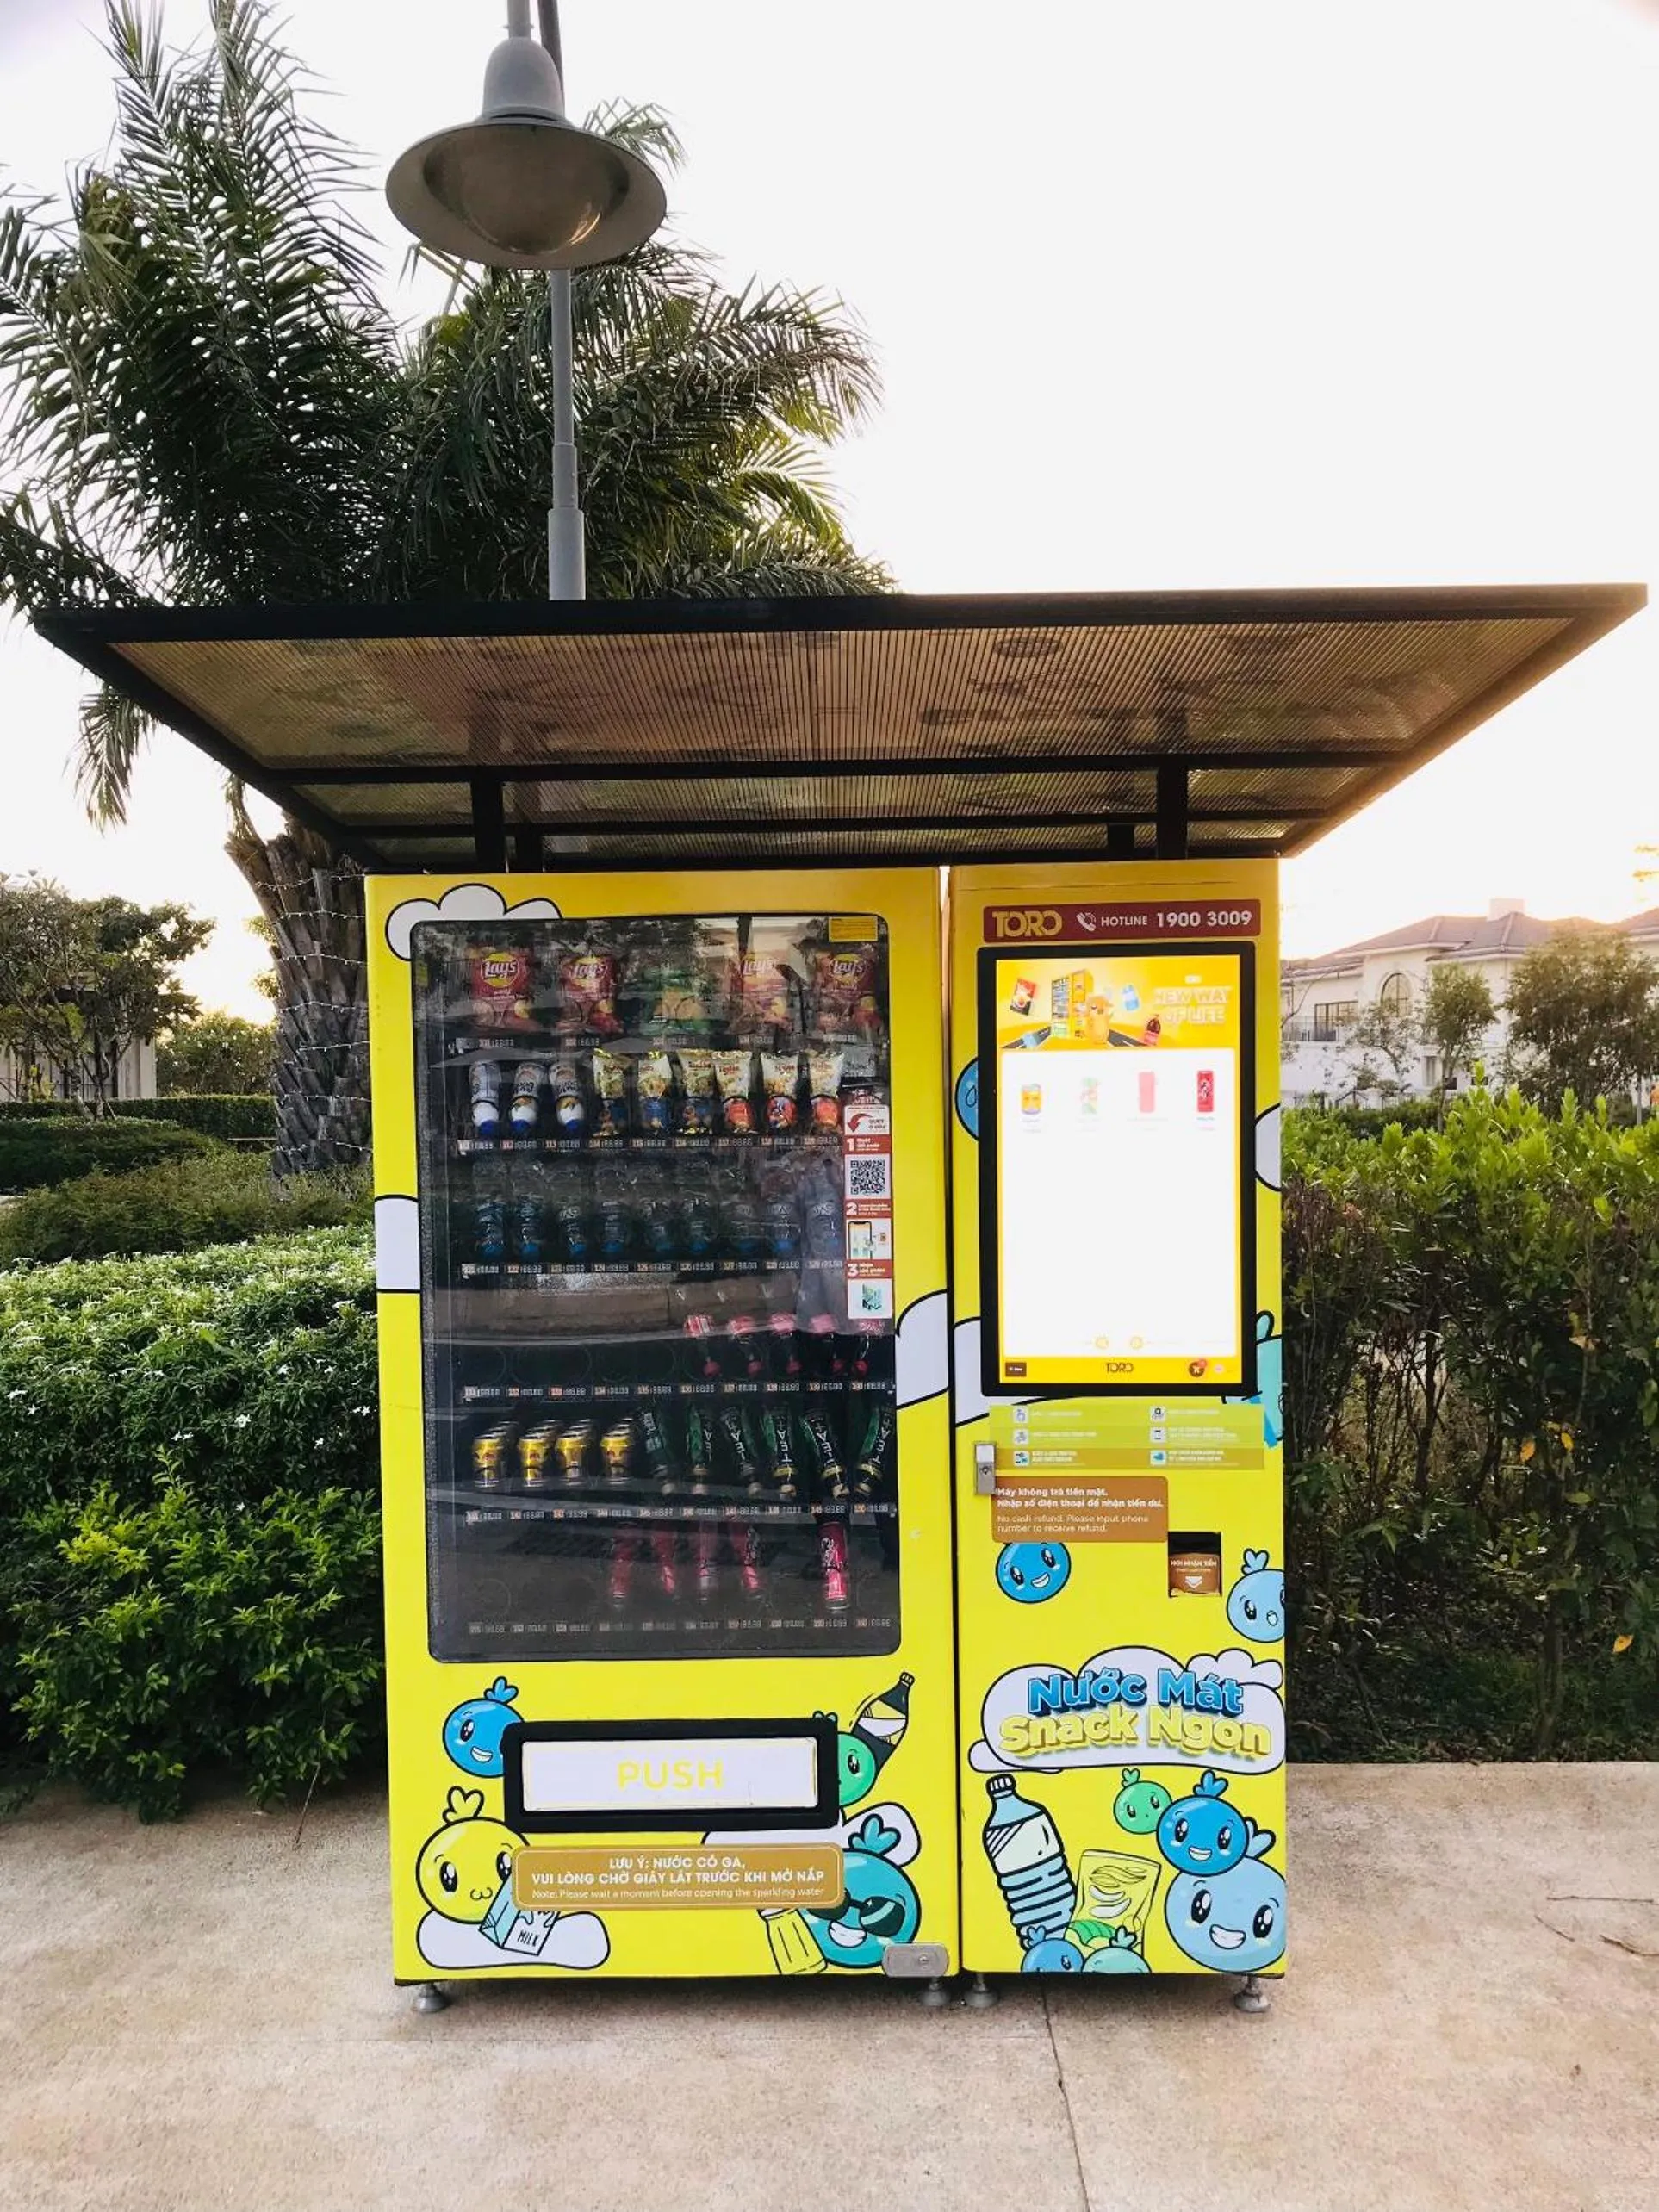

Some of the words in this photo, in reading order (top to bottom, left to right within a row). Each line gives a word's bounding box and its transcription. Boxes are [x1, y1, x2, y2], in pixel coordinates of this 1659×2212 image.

[992, 910, 1062, 937] TORO
[1101, 916, 1147, 927] HOTLINE
[1157, 911, 1201, 928] 1900
[1207, 910, 1252, 926] 3009
[847, 1138, 854, 1151] 1
[847, 1202, 857, 1215] 2
[848, 1264, 858, 1277] 3
[1028, 1668, 1147, 1715] Nước
[1158, 1668, 1244, 1714] Mát
[1000, 1706, 1138, 1755] Snack
[1147, 1706, 1271, 1755] Ngon
[617, 1759, 724, 1791] PUSH
[610, 1857, 632, 1869] LƯU
[653, 1855, 693, 1868] NƯỚC
[696, 1855, 718, 1868] CÓ
[722, 1857, 745, 1869] GA,
[532, 1873, 554, 1885] VUI
[744, 1870, 767, 1883] KHI
[560, 1889, 588, 1898] Please
[591, 1889, 610, 1898] wait
[620, 1890, 660, 1898] moment
[662, 1888, 693, 1898] before
[694, 1888, 733, 1898] opening
[736, 1886, 750, 1896] the
[753, 1886, 796, 1898] sparkling
[517, 1929, 540, 1947] MILK
